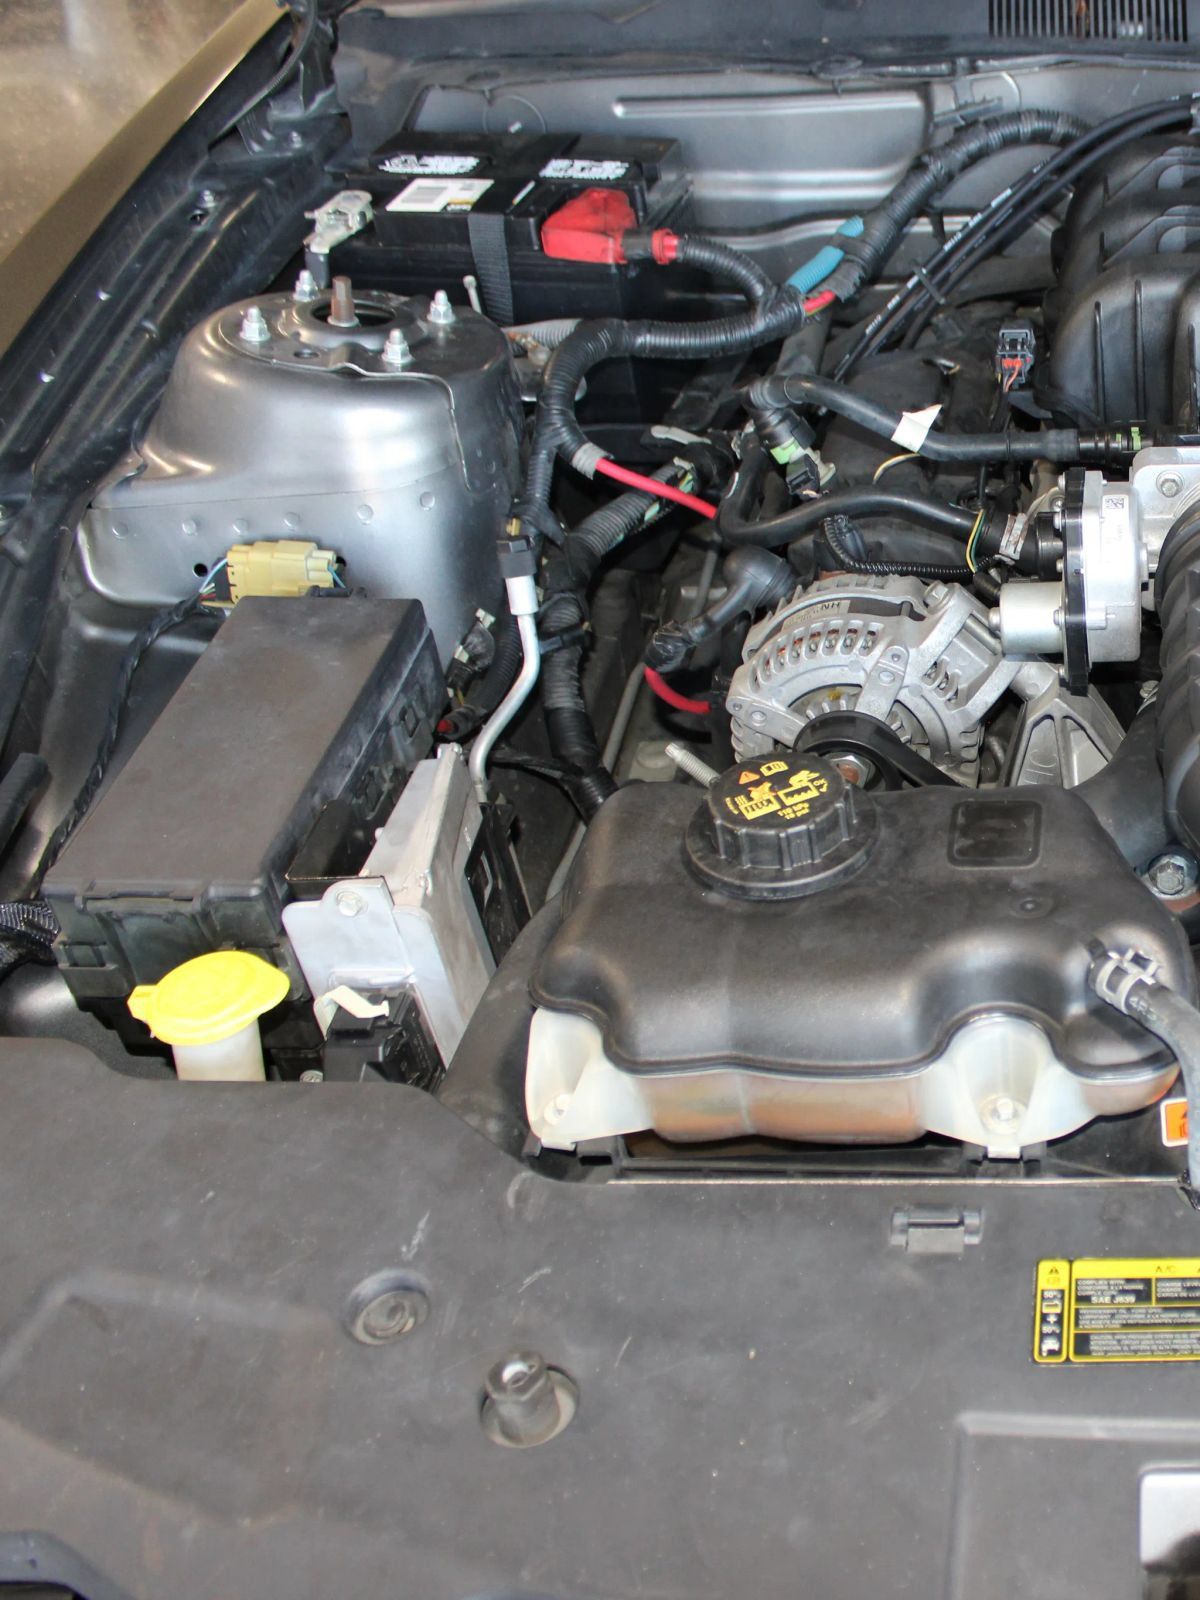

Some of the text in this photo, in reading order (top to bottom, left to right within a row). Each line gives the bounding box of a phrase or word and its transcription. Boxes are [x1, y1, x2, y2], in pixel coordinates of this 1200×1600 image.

[1043, 1290, 1061, 1299] 50%
[1090, 1295, 1112, 1304] SAE
[1041, 1326, 1060, 1335] 50%
